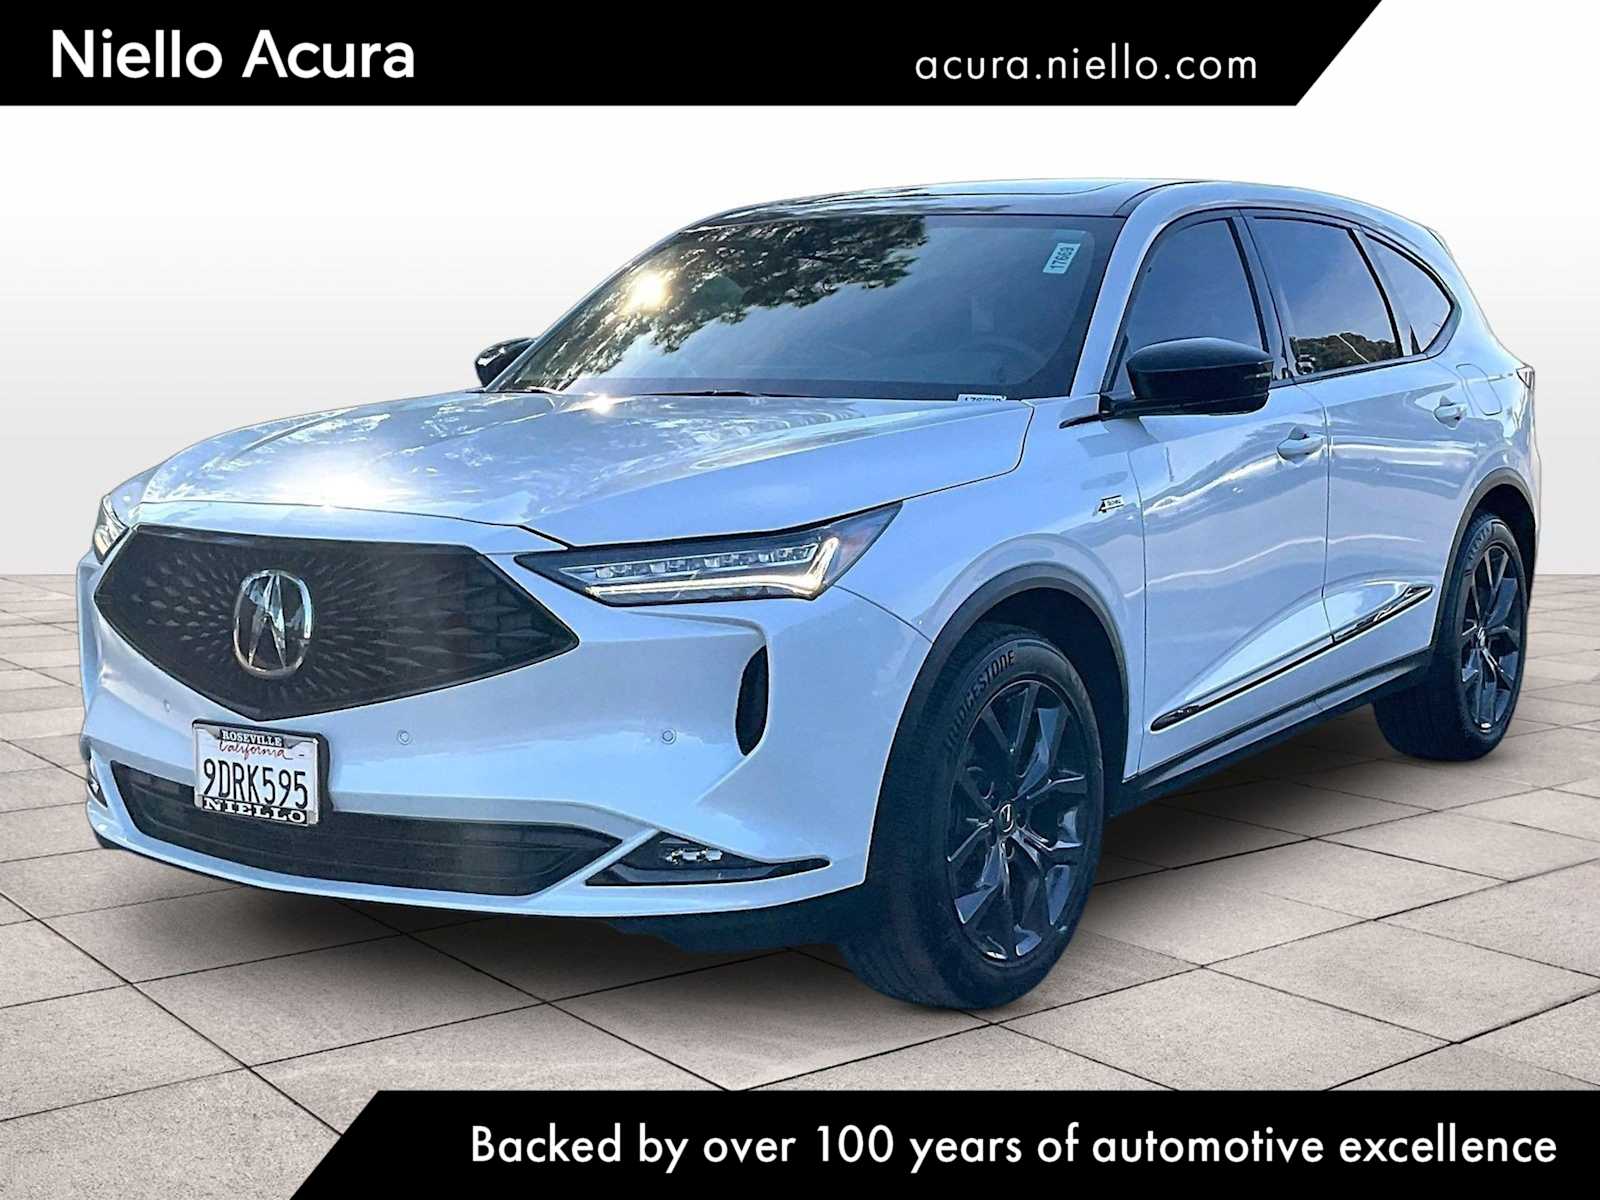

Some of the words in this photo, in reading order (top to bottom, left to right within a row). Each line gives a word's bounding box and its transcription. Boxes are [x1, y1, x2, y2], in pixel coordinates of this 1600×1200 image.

[221, 730, 283, 747] ROSEVILLE
[203, 758, 308, 809] 9DRK595
[203, 797, 306, 824] NIELLO
